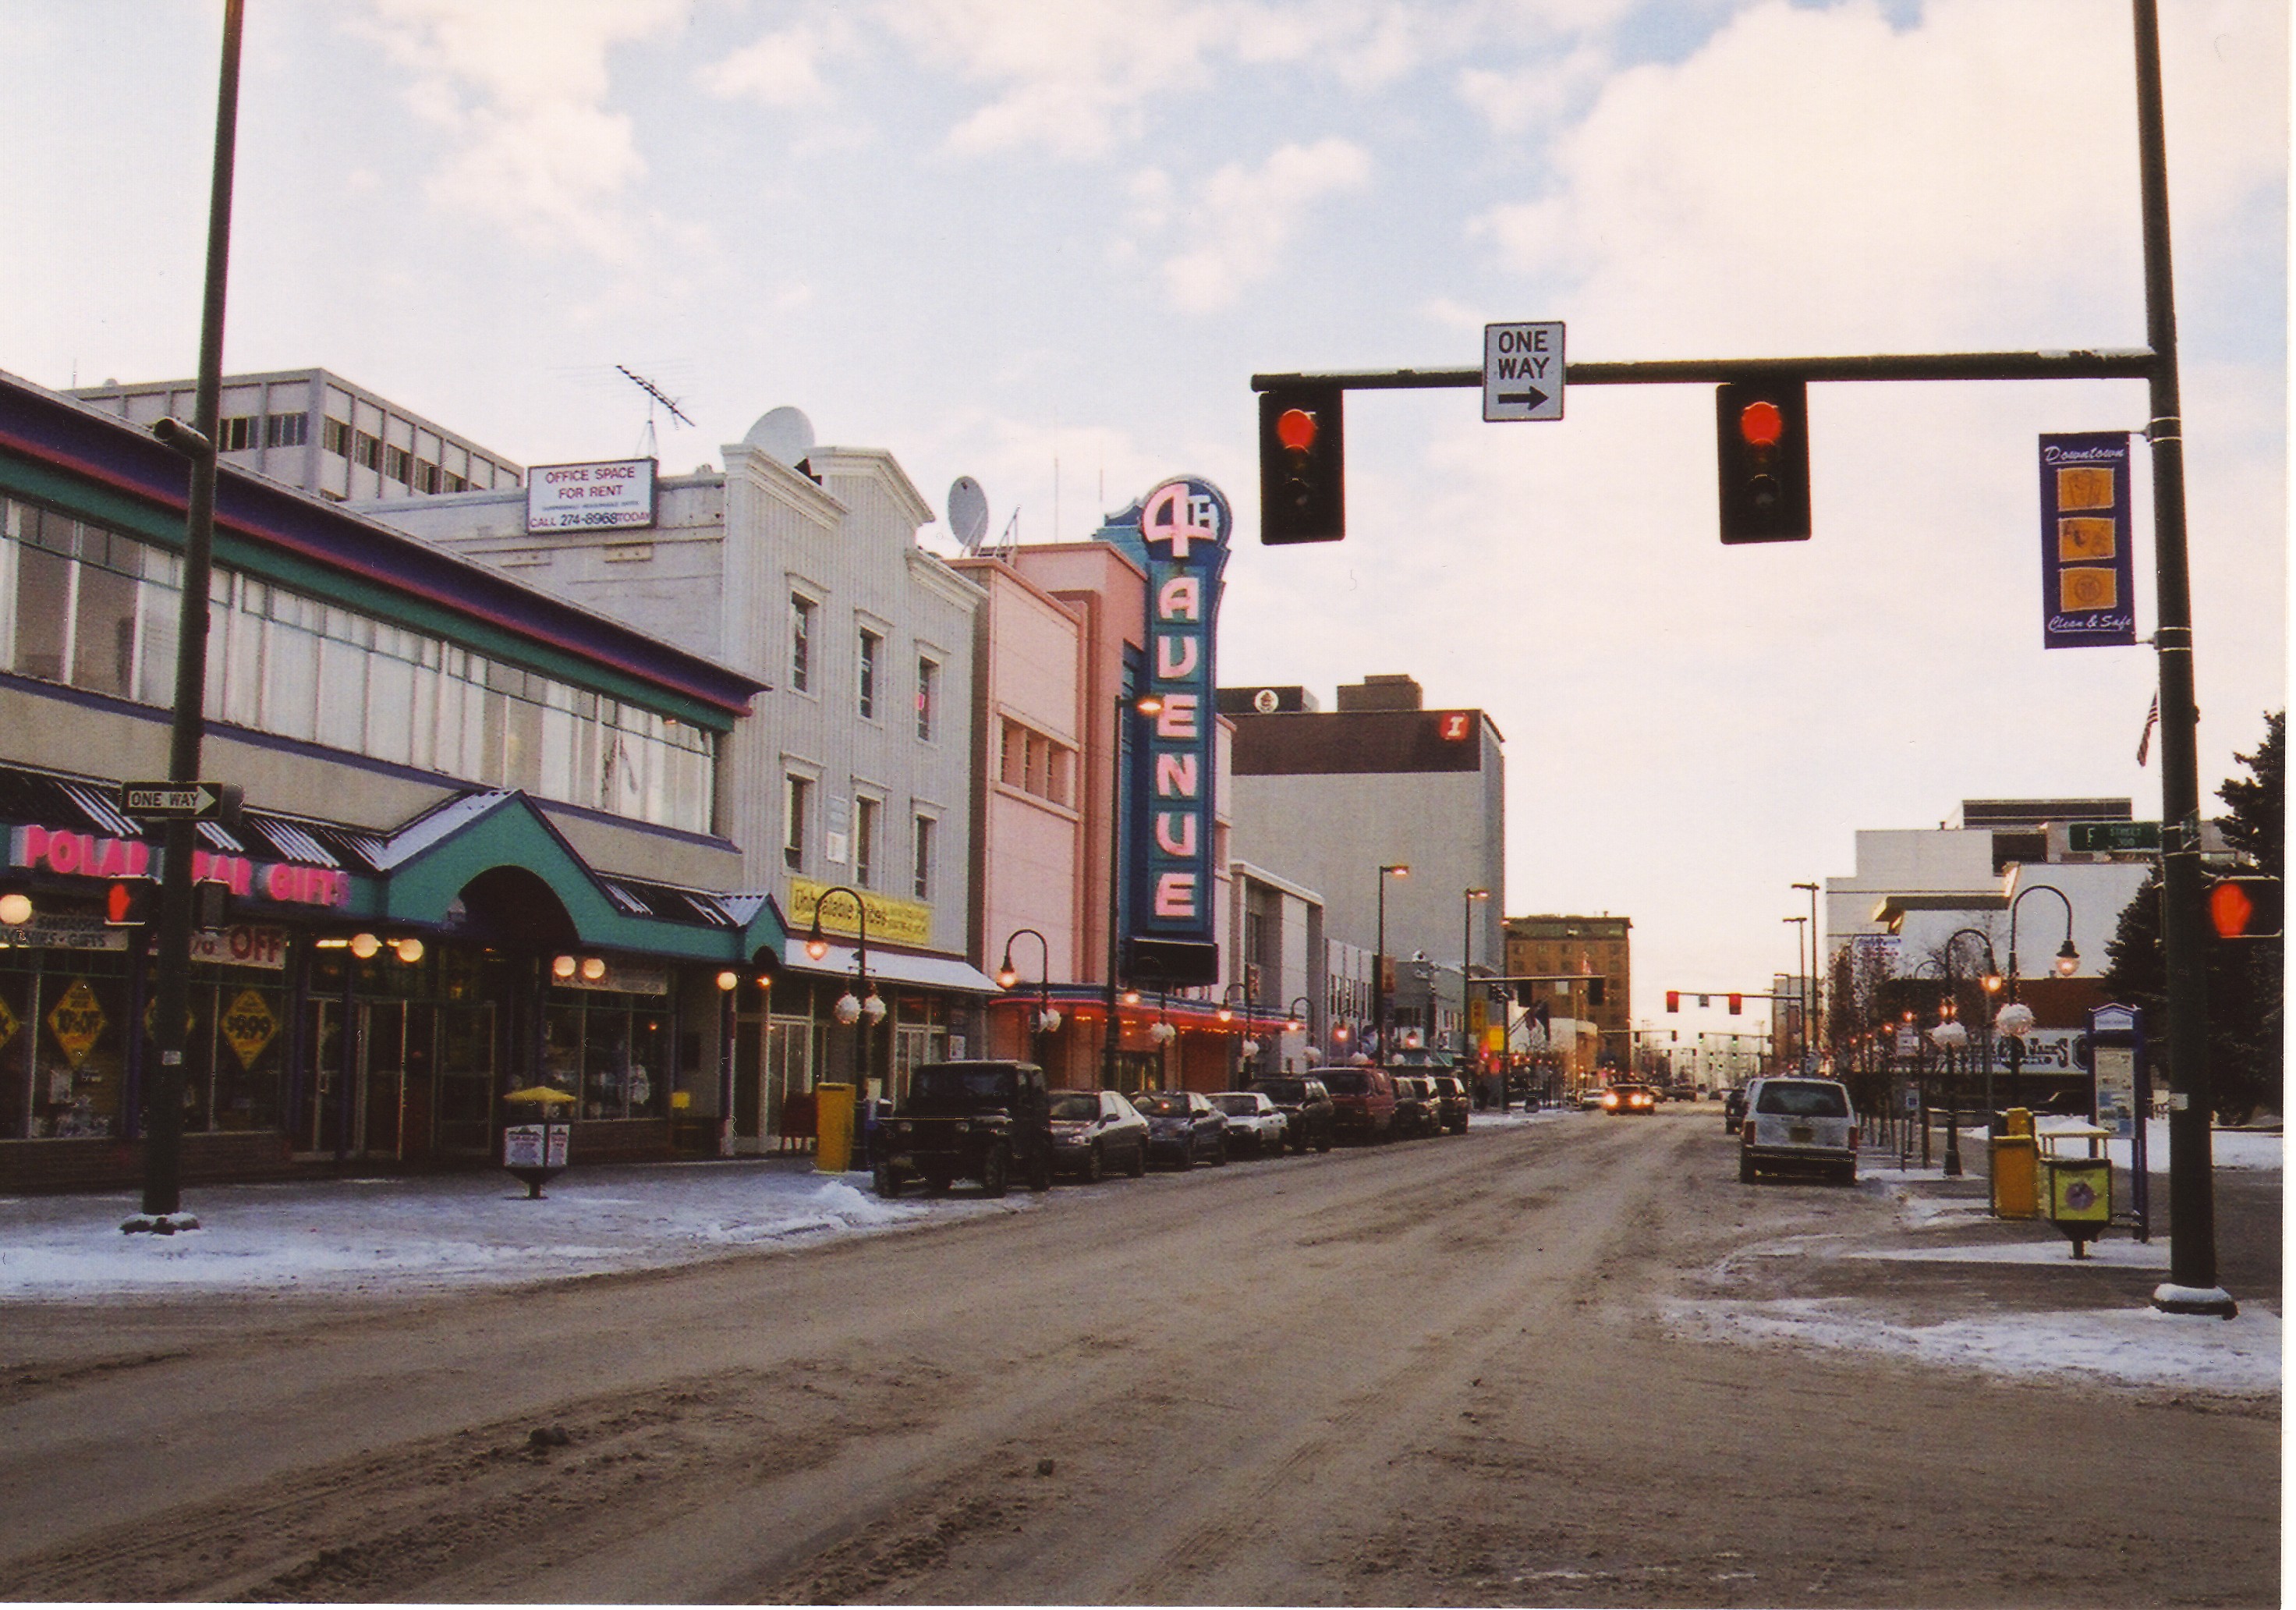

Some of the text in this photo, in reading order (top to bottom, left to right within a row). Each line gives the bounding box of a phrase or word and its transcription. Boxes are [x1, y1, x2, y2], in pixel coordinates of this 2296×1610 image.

[1498, 330, 1548, 353] ONE
[1498, 356, 1550, 380] WAY
[2044, 445, 2124, 462] Downtown
[545, 466, 635, 484] OFFICE SPACE
[558, 484, 623, 499] FOR RENT
[530, 517, 556, 527] CALL
[2048, 615, 2132, 633] Clean & Safe
[1155, 577, 1199, 917] AVENUE
[131, 791, 200, 807] ONE WAY
[2086, 827, 2096, 847] F
[24, 824, 150, 877] POLAR
[271, 863, 349, 906] GIFTS
[229, 925, 282, 963] OFF
